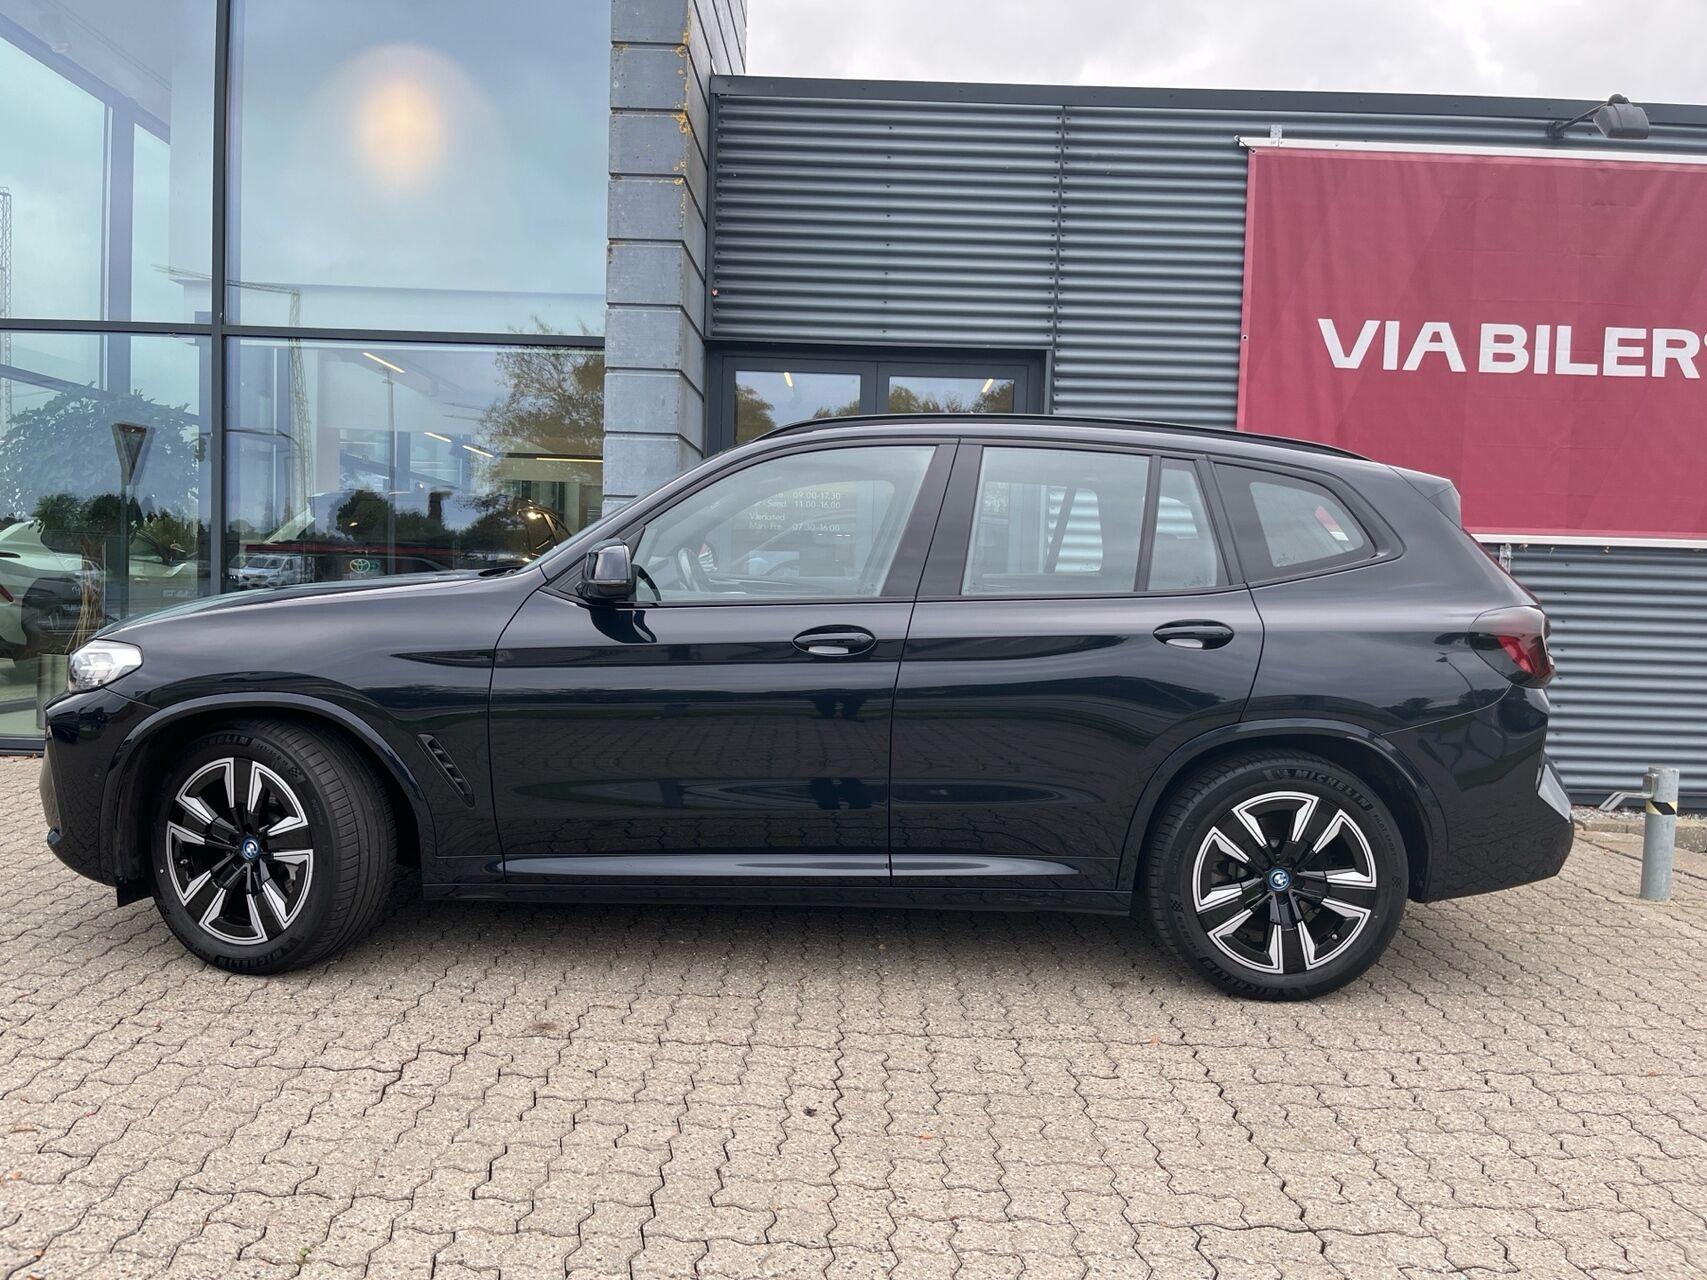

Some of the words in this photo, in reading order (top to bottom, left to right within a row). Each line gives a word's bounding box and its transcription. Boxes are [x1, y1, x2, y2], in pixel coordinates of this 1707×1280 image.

[1317, 318, 1467, 373] VIA
[1478, 322, 1701, 379] BILER
[1293, 769, 1371, 811] MICHELIN
